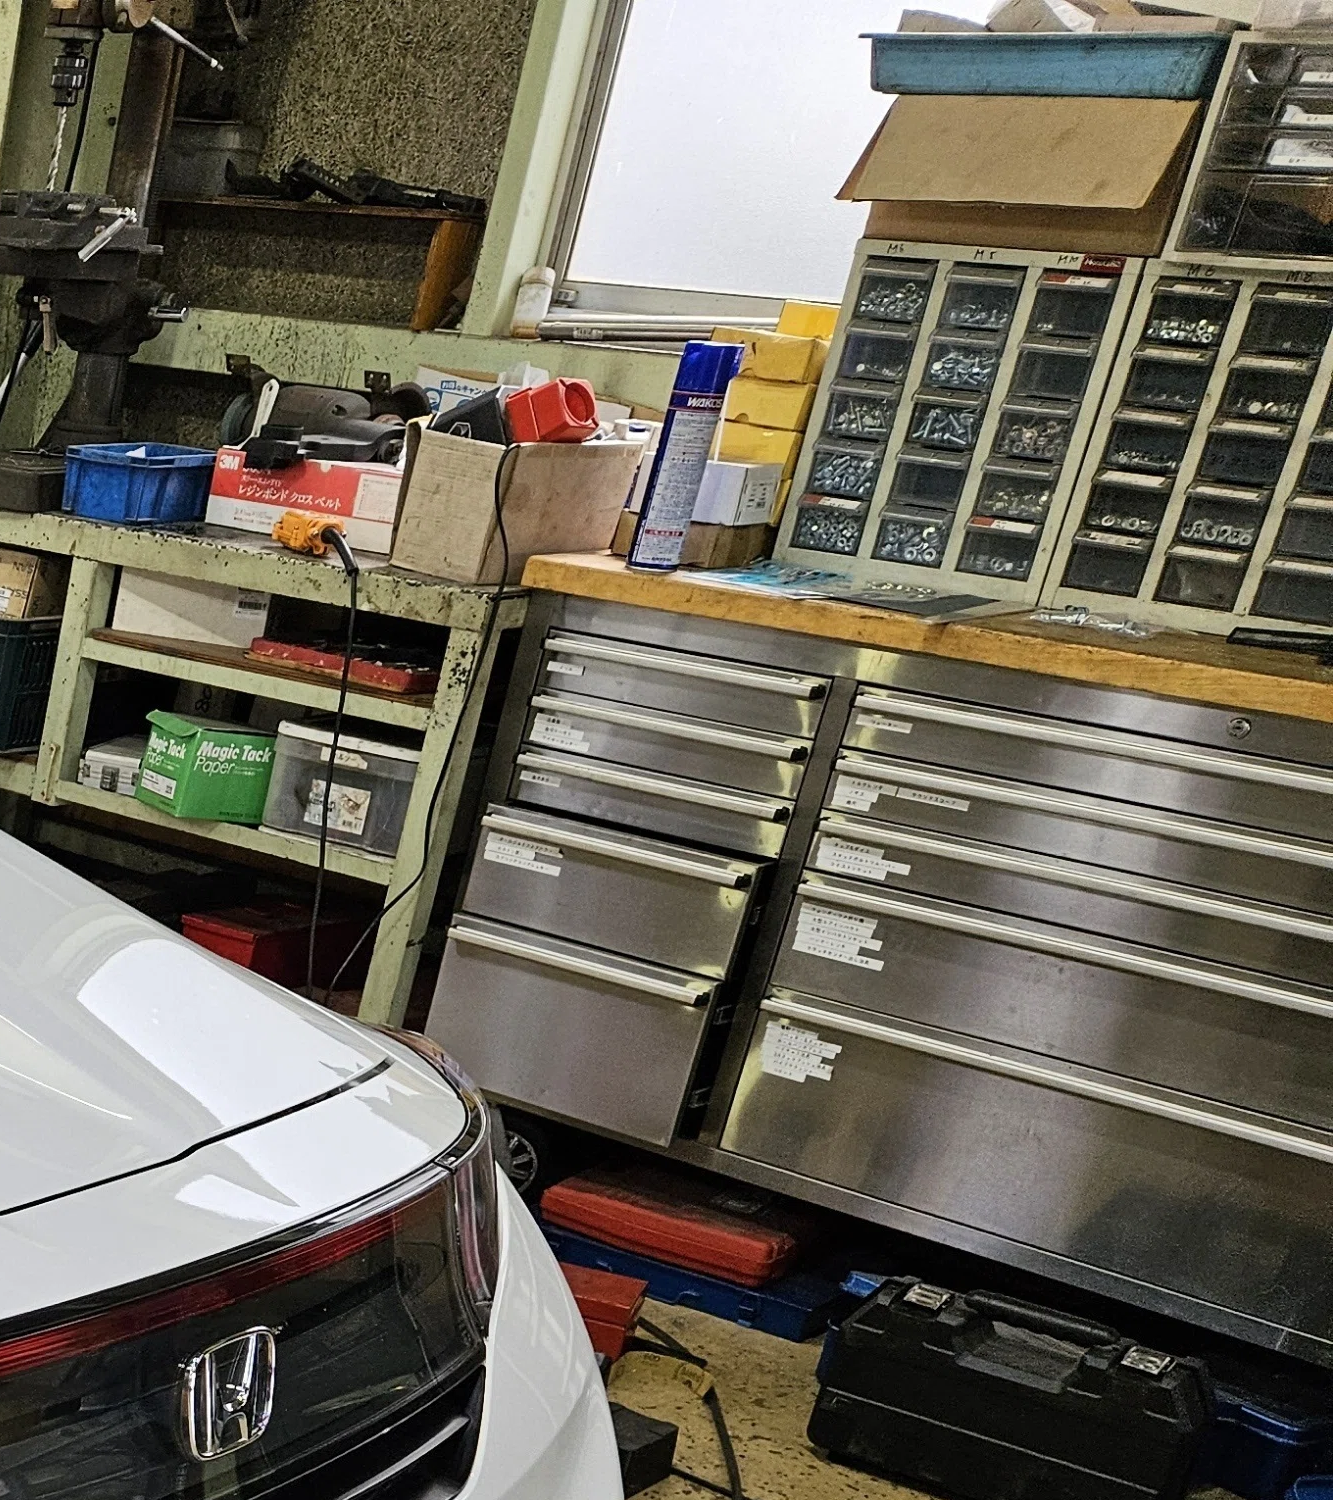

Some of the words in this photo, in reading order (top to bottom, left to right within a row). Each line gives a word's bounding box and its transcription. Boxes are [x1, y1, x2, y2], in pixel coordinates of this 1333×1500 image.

[218, 453, 241, 471] 3M
[237, 483, 289, 503] レジンボンド
[289, 492, 314, 507] クロス
[314, 496, 342, 512] ベルト
[147, 731, 170, 754] Magic
[167, 738, 187, 760] Tack
[196, 740, 240, 763] Magic
[240, 744, 273, 763] Tack
[145, 747, 164, 768] Paper
[193, 756, 236, 777] Paper
